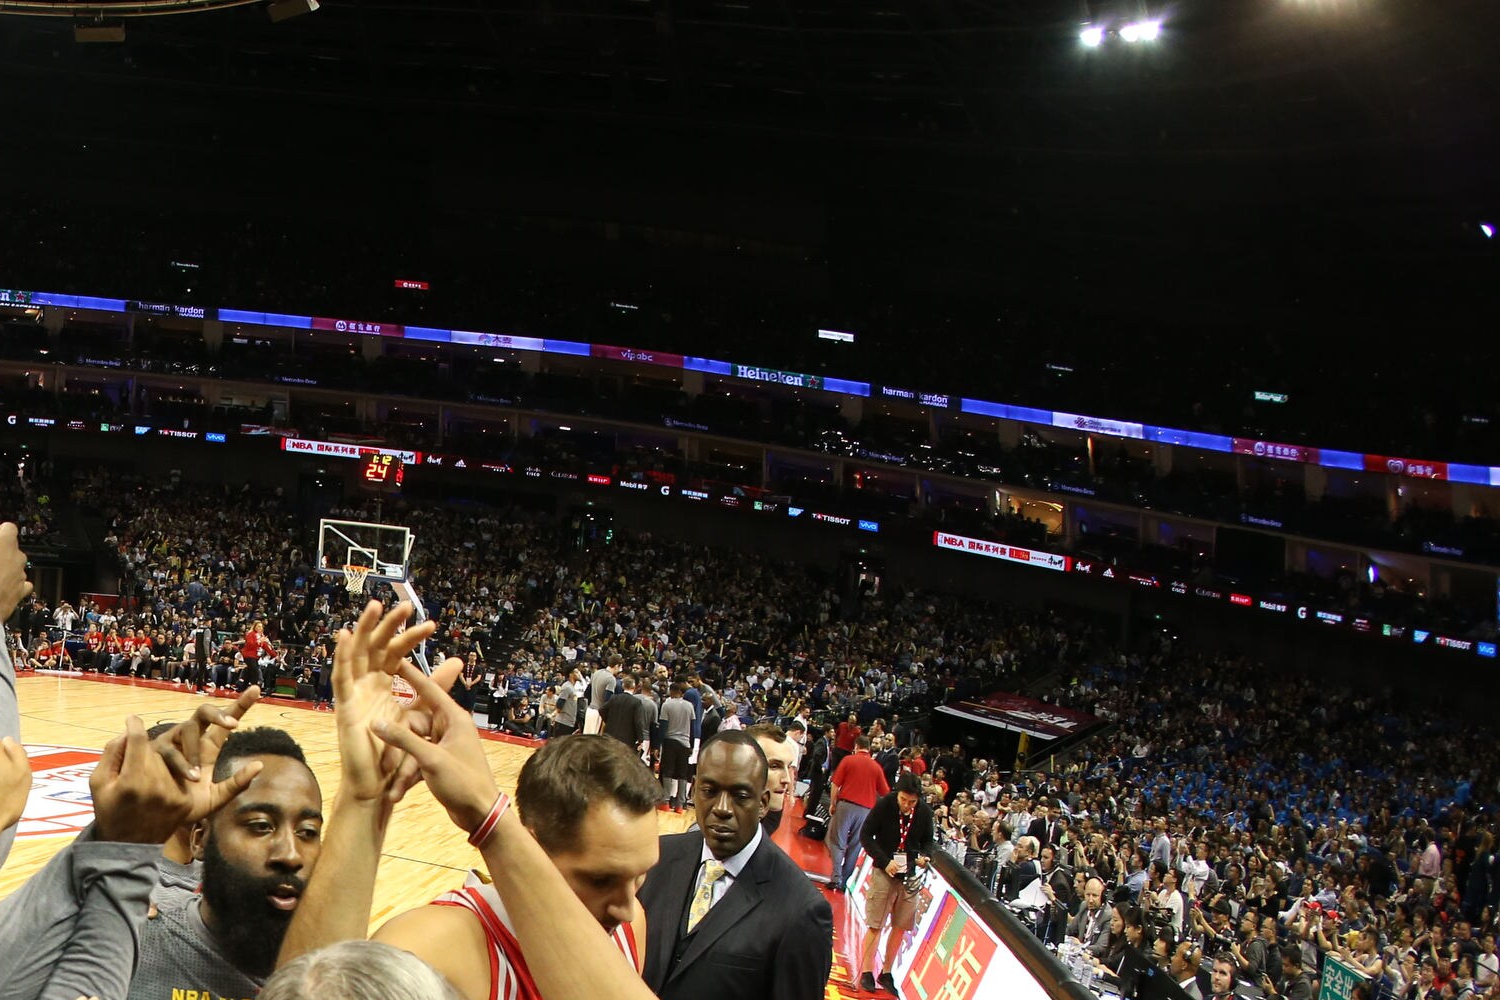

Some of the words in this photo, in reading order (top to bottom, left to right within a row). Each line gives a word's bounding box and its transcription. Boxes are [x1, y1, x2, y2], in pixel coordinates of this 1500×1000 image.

[139, 301, 171, 312] harman
[175, 305, 205, 316] kardon
[620, 350, 654, 362] vipabc
[736, 365, 804, 386] Heineken
[882, 386, 915, 399] harman
[919, 392, 948, 404] kardon
[7, 415, 17, 425] G
[169, 430, 198, 439] TISSOT
[206, 433, 224, 441] vivo
[292, 441, 313, 451] NBA
[373, 454, 393, 466] 1:12
[366, 463, 388, 479] 24
[620, 480, 637, 489] Mobil
[660, 485, 670, 496] G
[822, 514, 851, 525] TISSOT
[860, 522, 878, 530] vivo
[944, 536, 965, 548] NBA
[1260, 601, 1277, 610] Mobil
[1297, 606, 1307, 619] G
